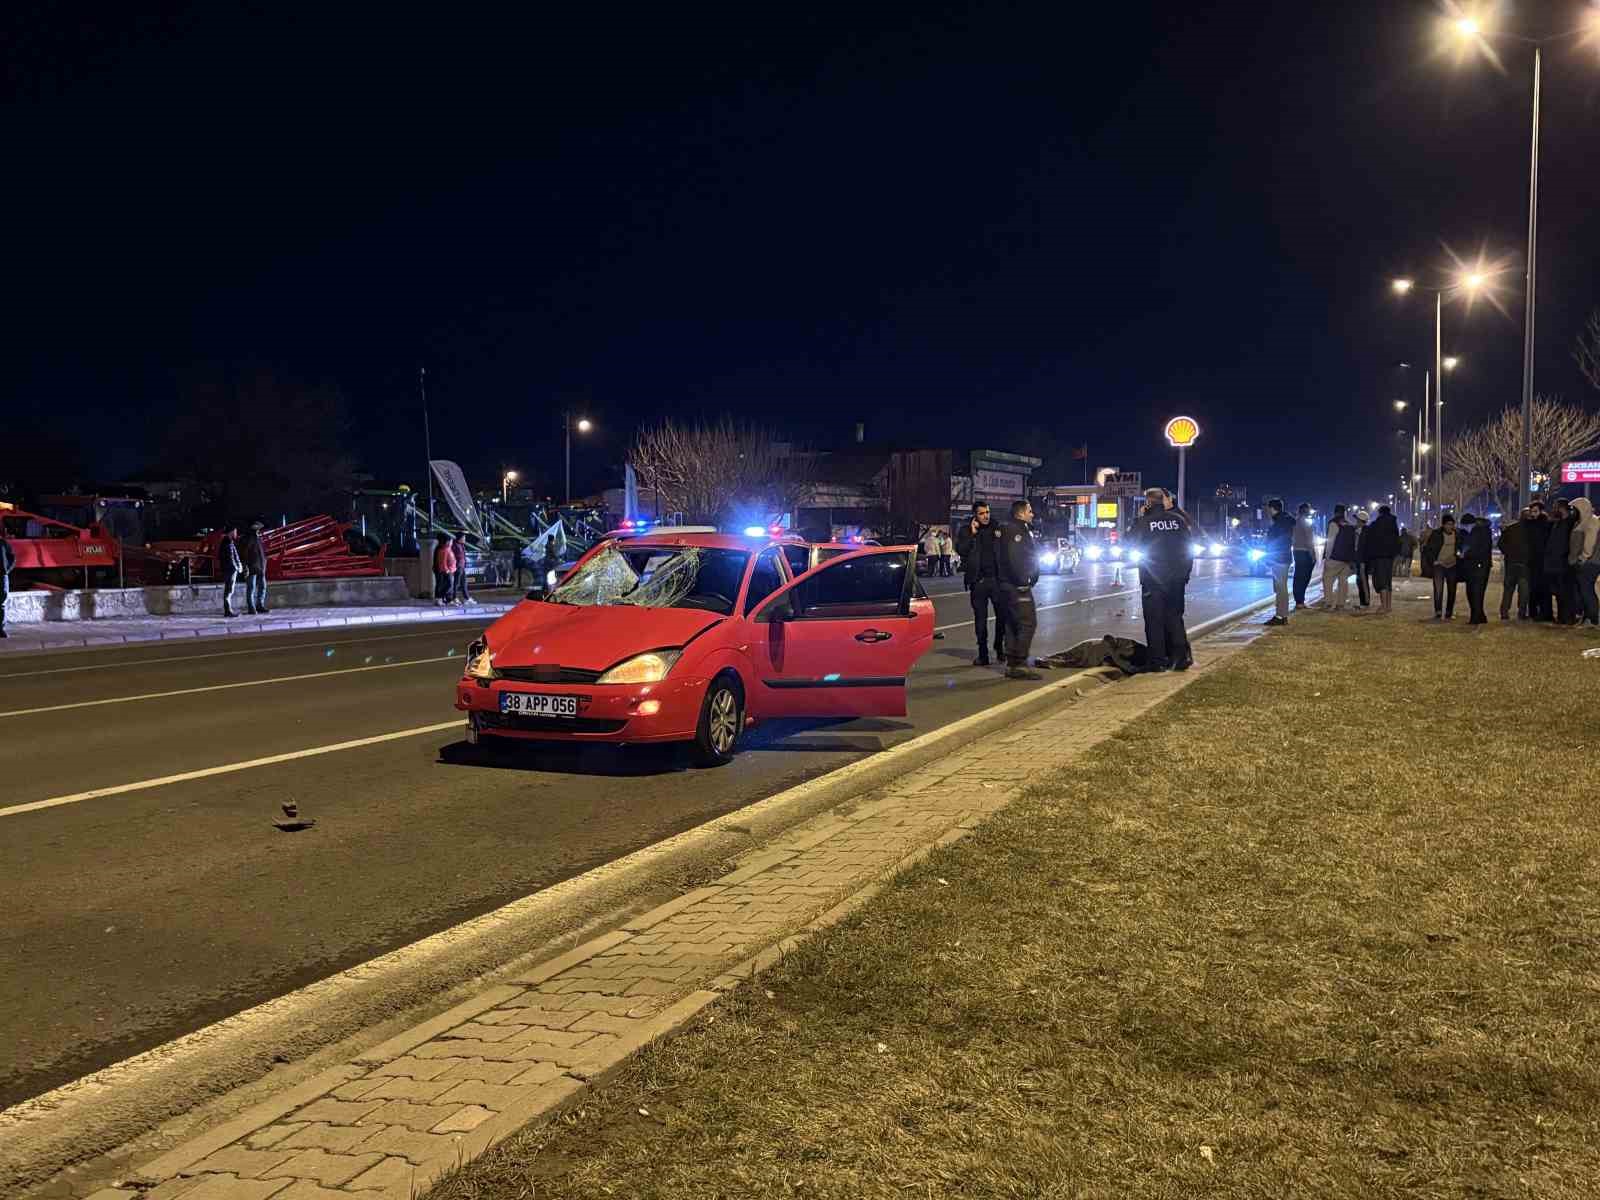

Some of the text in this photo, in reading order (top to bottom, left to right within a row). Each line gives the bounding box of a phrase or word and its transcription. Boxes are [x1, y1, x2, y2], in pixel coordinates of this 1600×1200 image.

[506, 695, 575, 712] 38 APP 056
